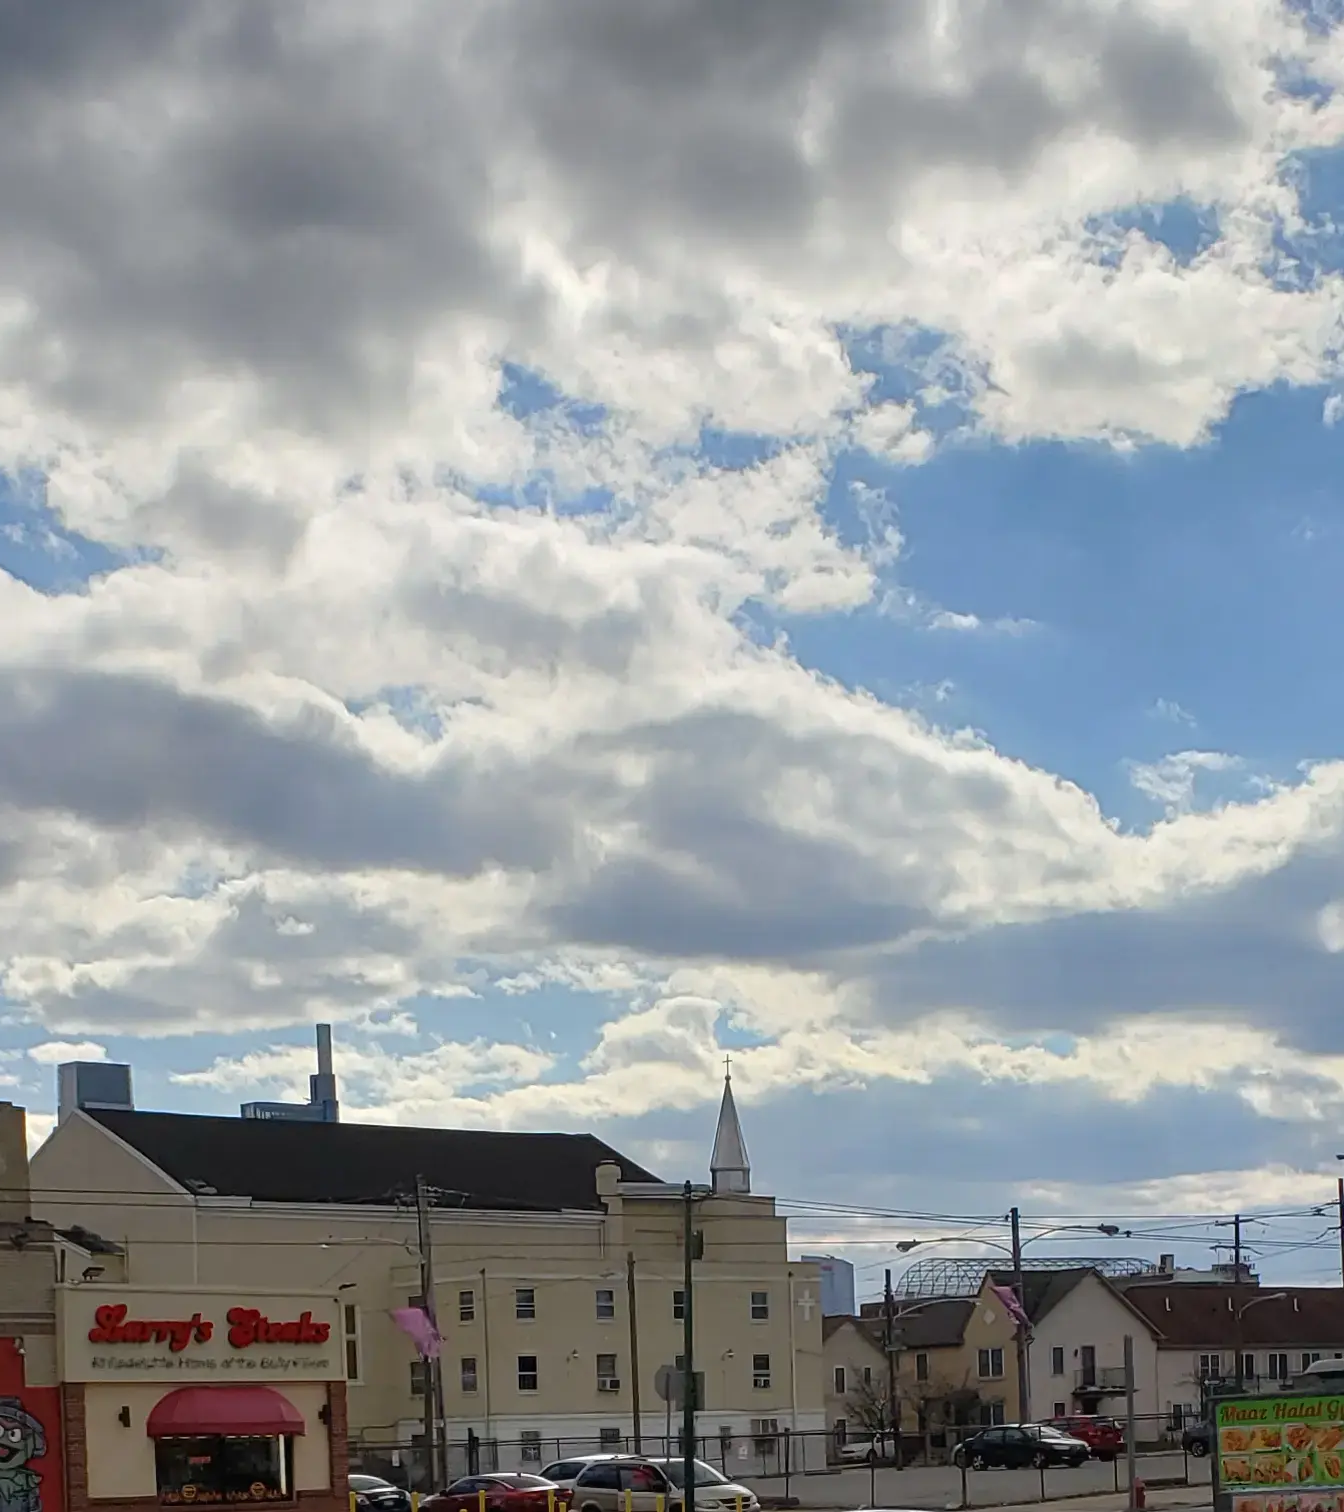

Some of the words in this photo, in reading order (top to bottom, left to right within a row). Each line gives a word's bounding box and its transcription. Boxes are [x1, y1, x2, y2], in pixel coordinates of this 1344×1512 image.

[88, 1303, 214, 1353] Larry's
[227, 1306, 331, 1349] Steaks
[1273, 1401, 1323, 1420] Halal
